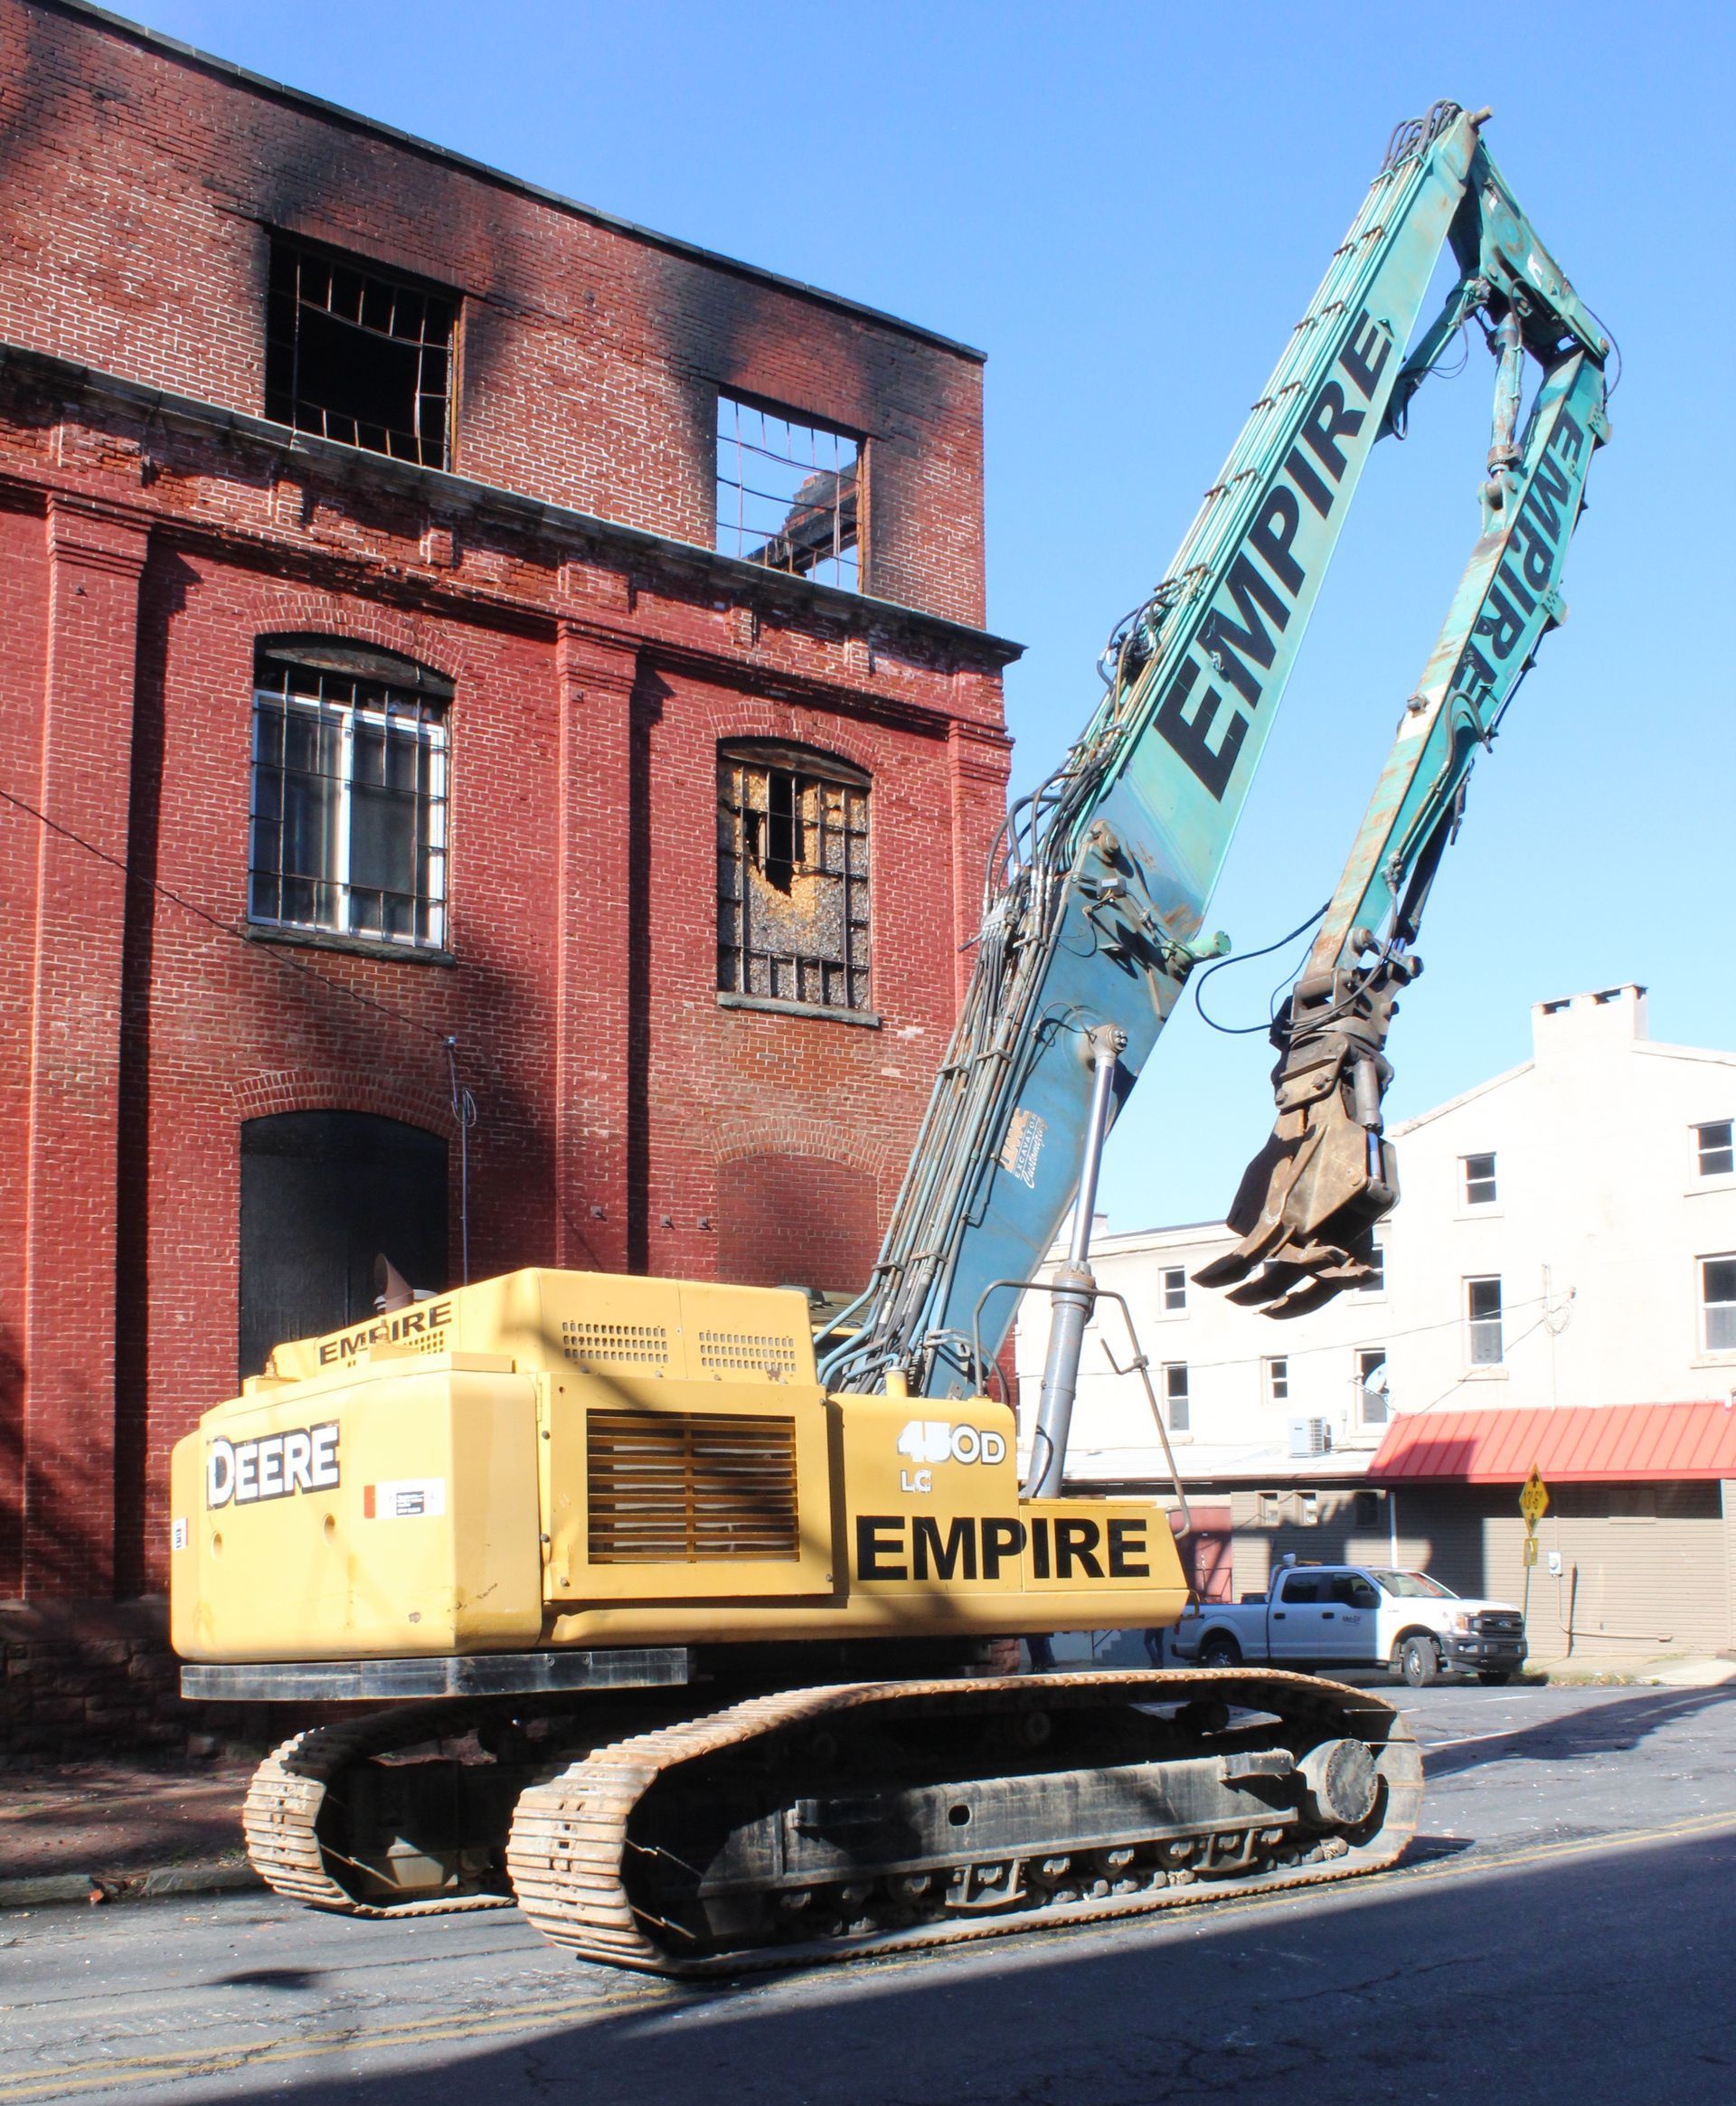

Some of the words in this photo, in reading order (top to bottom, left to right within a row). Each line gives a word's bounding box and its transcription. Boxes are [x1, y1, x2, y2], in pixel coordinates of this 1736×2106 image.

[1152, 308, 1393, 802] EMPIRE
[1451, 404, 1584, 710] EMPIRE
[320, 1300, 452, 1365] EMPIRE
[206, 1419, 339, 1511] DEERE
[901, 1469, 932, 1493] LC
[855, 1516, 1150, 1581] EMPIRE
